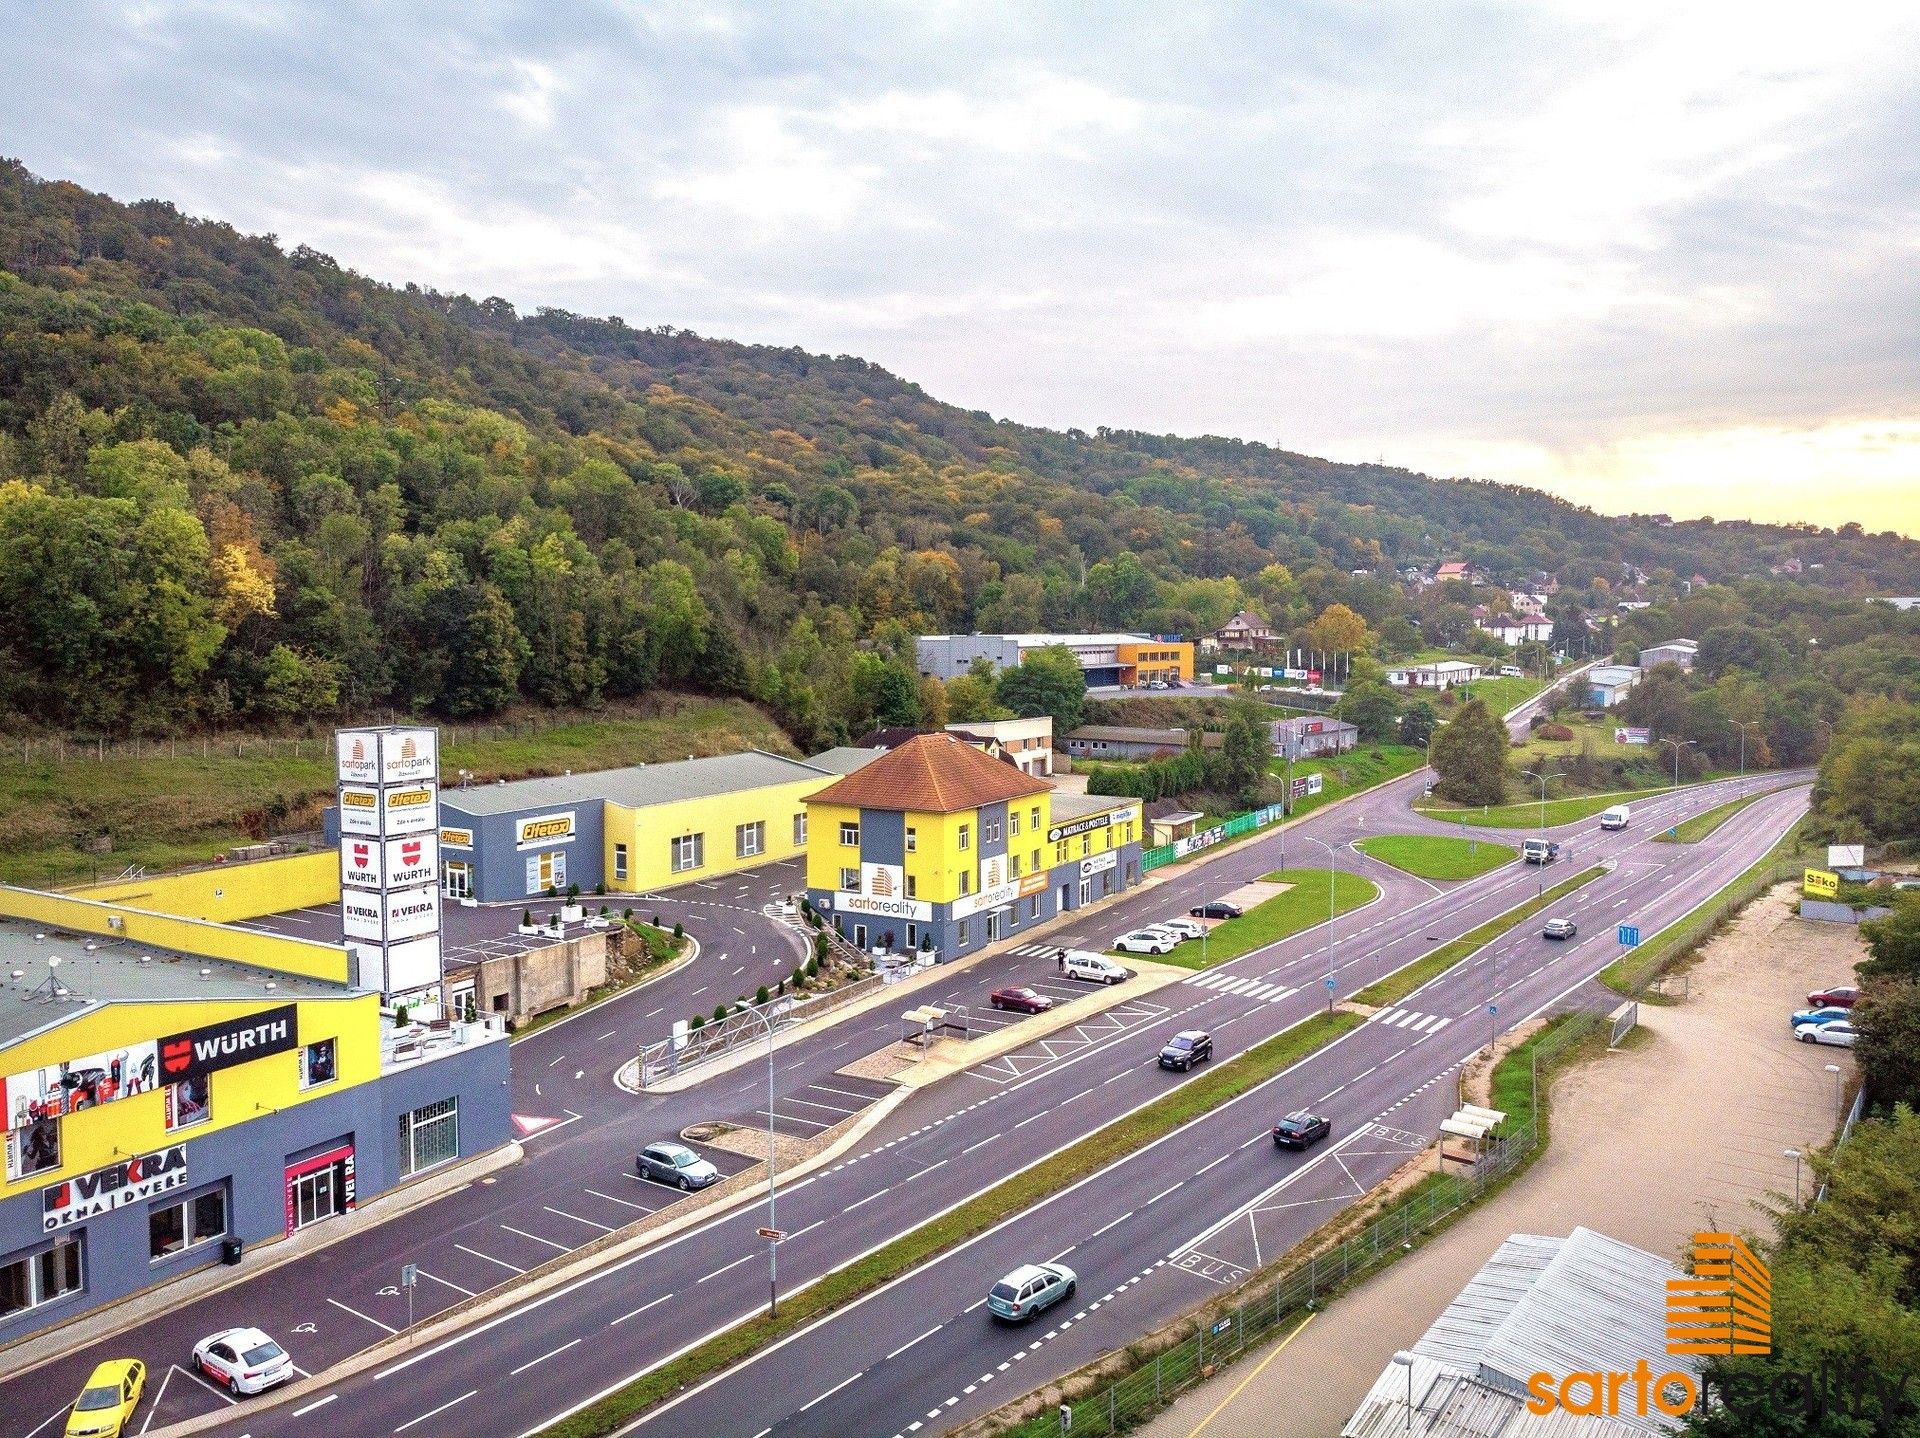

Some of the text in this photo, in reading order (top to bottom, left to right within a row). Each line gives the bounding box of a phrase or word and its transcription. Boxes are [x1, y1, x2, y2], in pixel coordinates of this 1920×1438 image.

[342, 760, 376, 770] sartopark
[386, 757, 431, 770] sartopark
[389, 791, 430, 805] Elfetex
[1089, 816, 1108, 828] POSTELE
[524, 821, 568, 839] Elfetex
[347, 870, 377, 883] WÜRTH
[393, 867, 431, 882] WÜRTH
[353, 906, 379, 918] VEKRA
[401, 902, 433, 916] VEKRA
[849, 897, 917, 917] sartoreality
[195, 1019, 287, 1061] WÜRTH
[1374, 1127, 1427, 1147] BUS
[74, 1147, 186, 1200] VEKRA
[45, 1202, 103, 1229] OKNA
[1179, 1254, 1243, 1284] BUS
